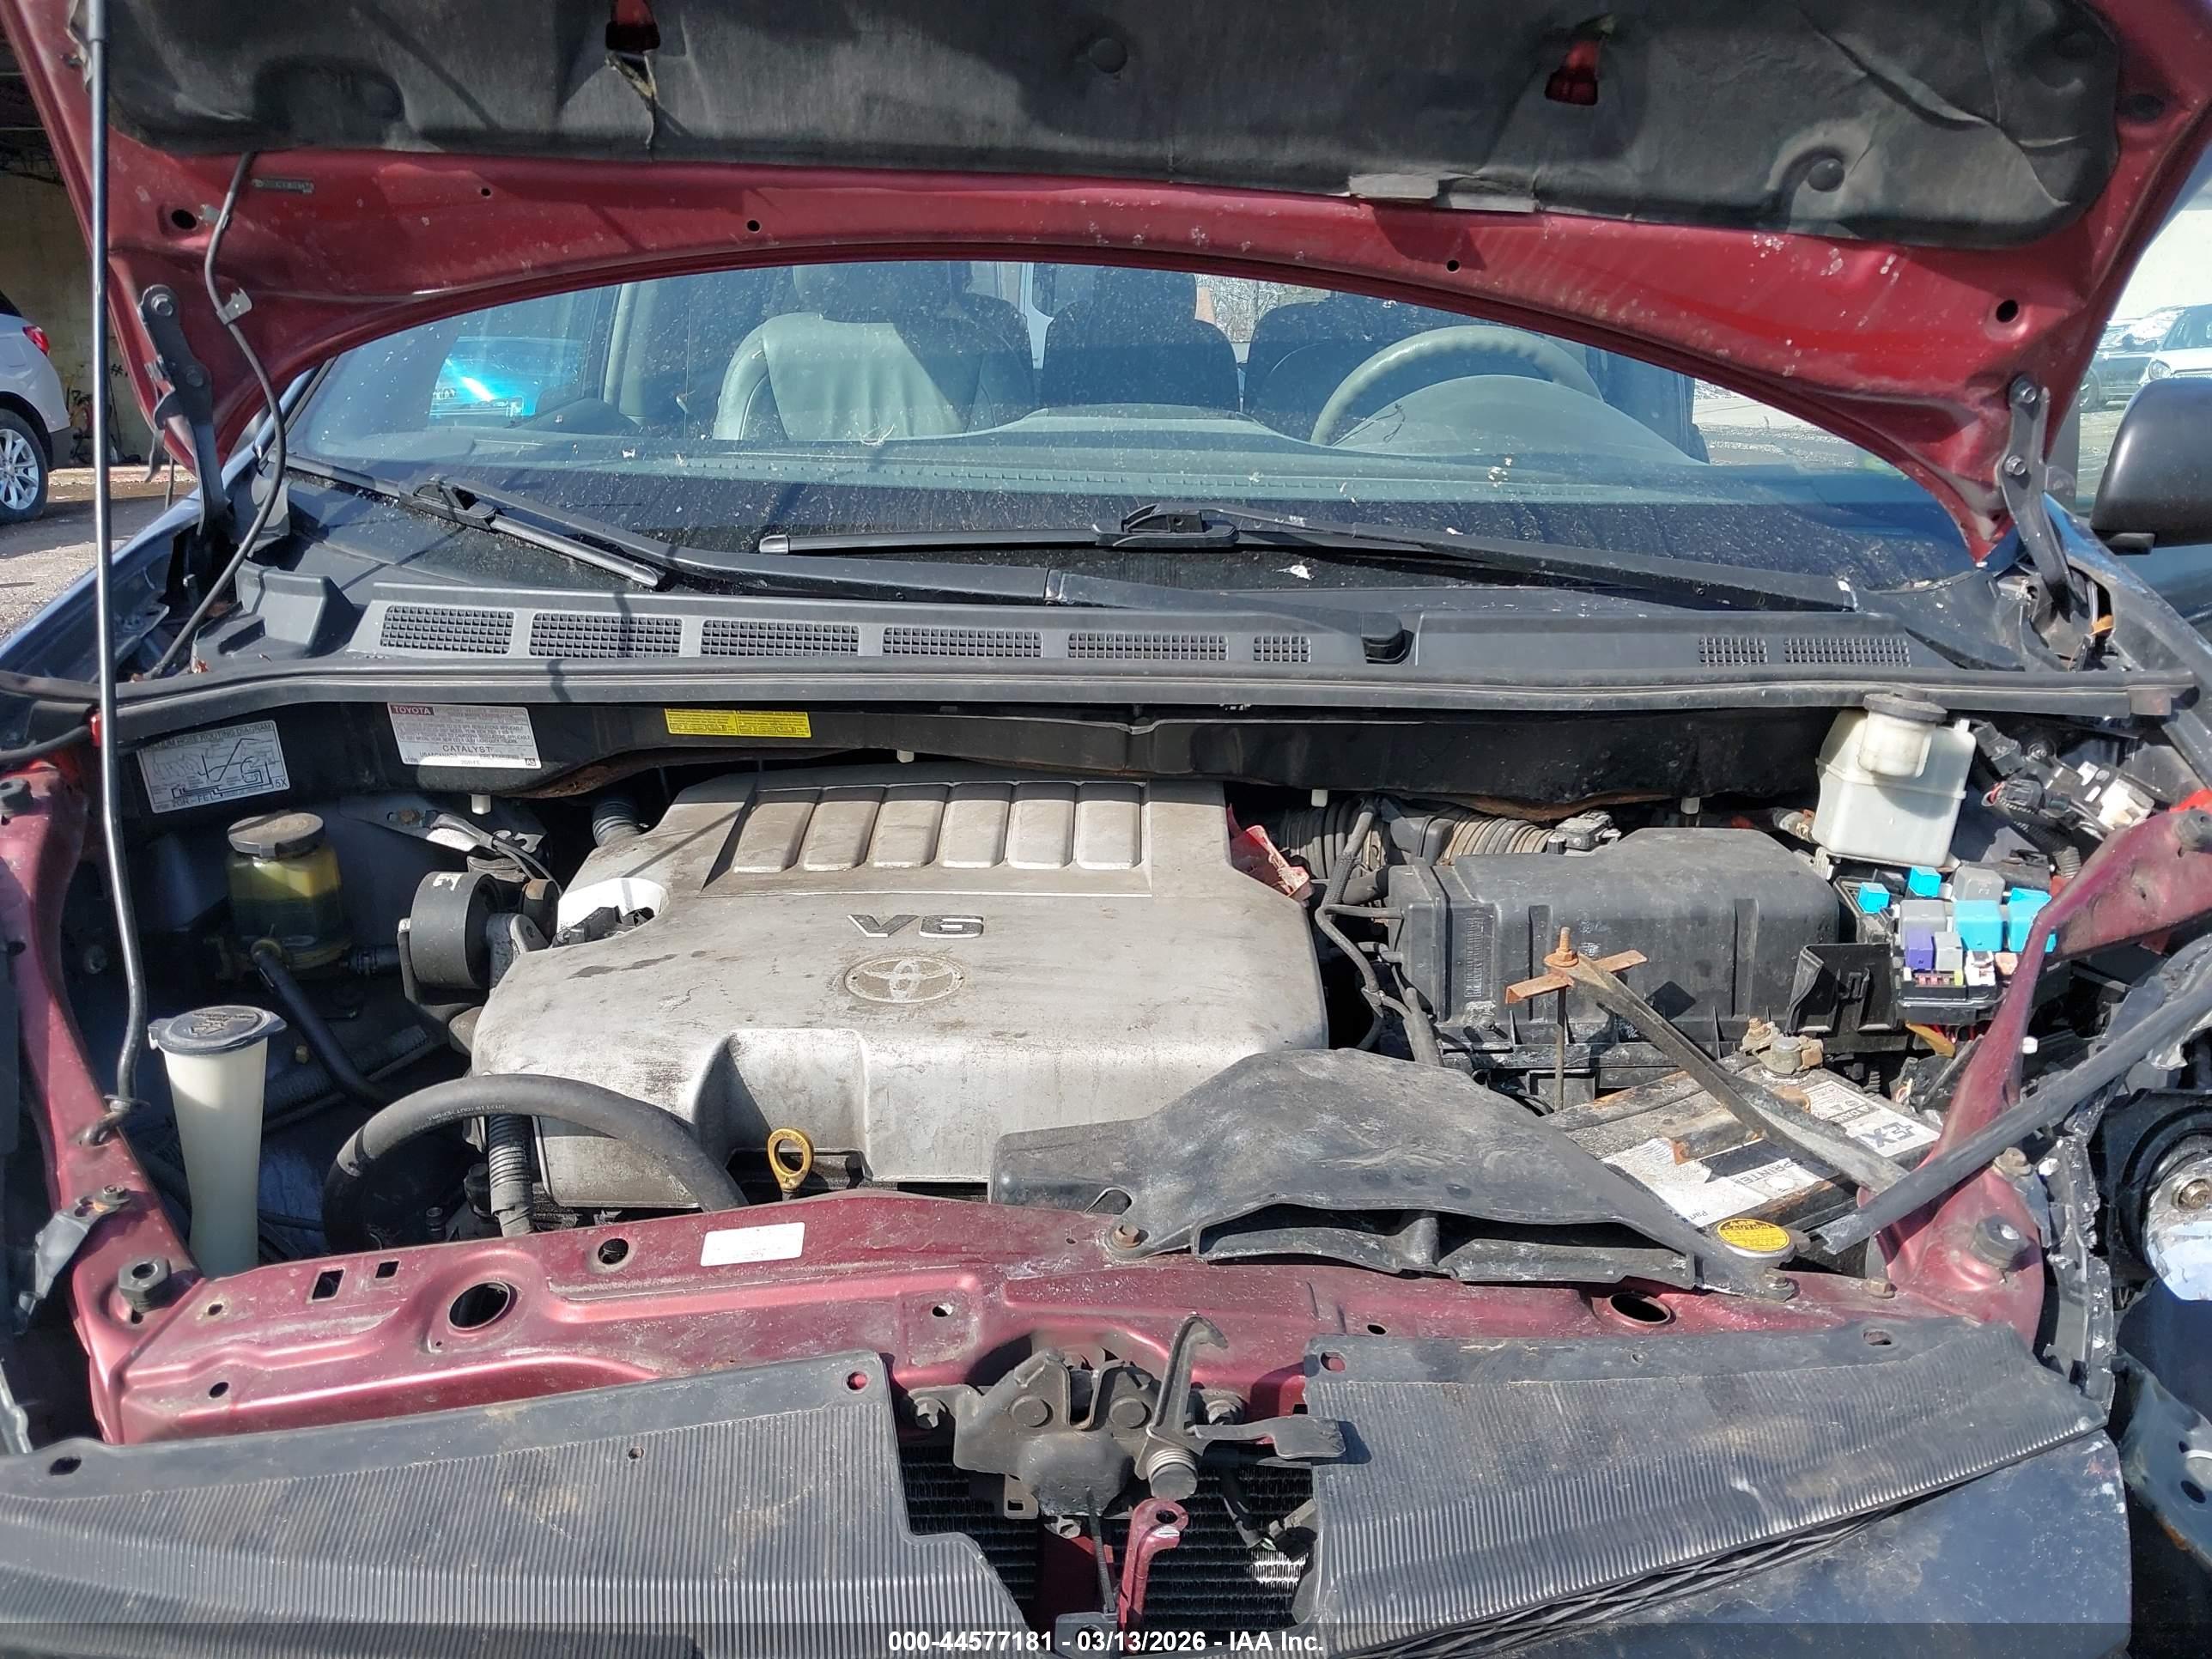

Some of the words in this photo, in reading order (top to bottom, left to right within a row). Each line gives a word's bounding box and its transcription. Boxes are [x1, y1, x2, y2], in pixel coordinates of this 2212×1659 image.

[393, 705, 432, 715] TOYOTA
[442, 744, 491, 753] CATALYST
[847, 914, 985, 939] V6
